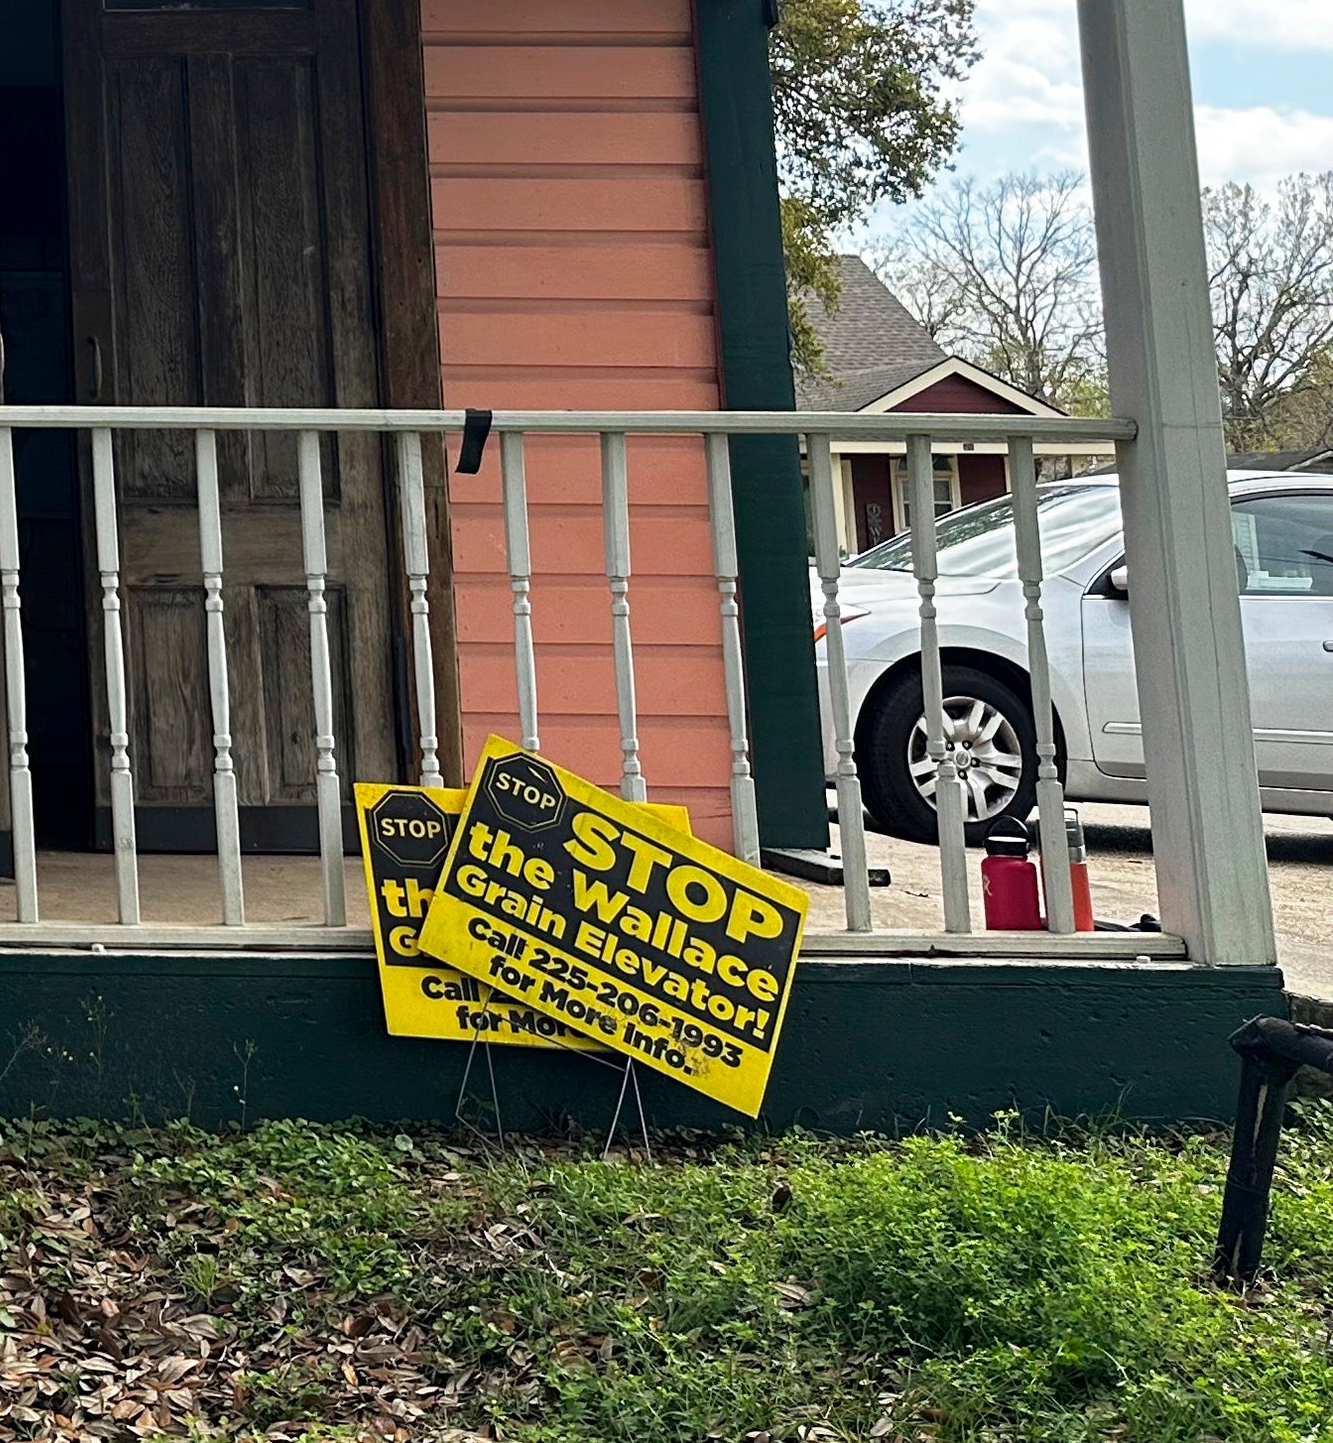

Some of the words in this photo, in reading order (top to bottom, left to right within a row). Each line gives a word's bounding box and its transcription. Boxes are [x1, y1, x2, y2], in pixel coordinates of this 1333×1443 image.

[380, 818, 442, 840] STOP
[495, 771, 557, 811] STOP
[381, 878, 435, 918] th
[468, 820, 556, 891] the
[572, 869, 780, 1003] Wallace
[563, 811, 785, 945] STOP
[420, 975, 479, 1001] Call
[455, 864, 567, 940] Grain
[573, 920, 771, 1040] Elevator!
[455, 1004, 503, 1032] for
[466, 917, 529, 959] Call
[528, 947, 744, 1069] 225-206-1993
[488, 955, 537, 994] for
[538, 981, 619, 1037] More
[622, 1022, 693, 1077] Info.
